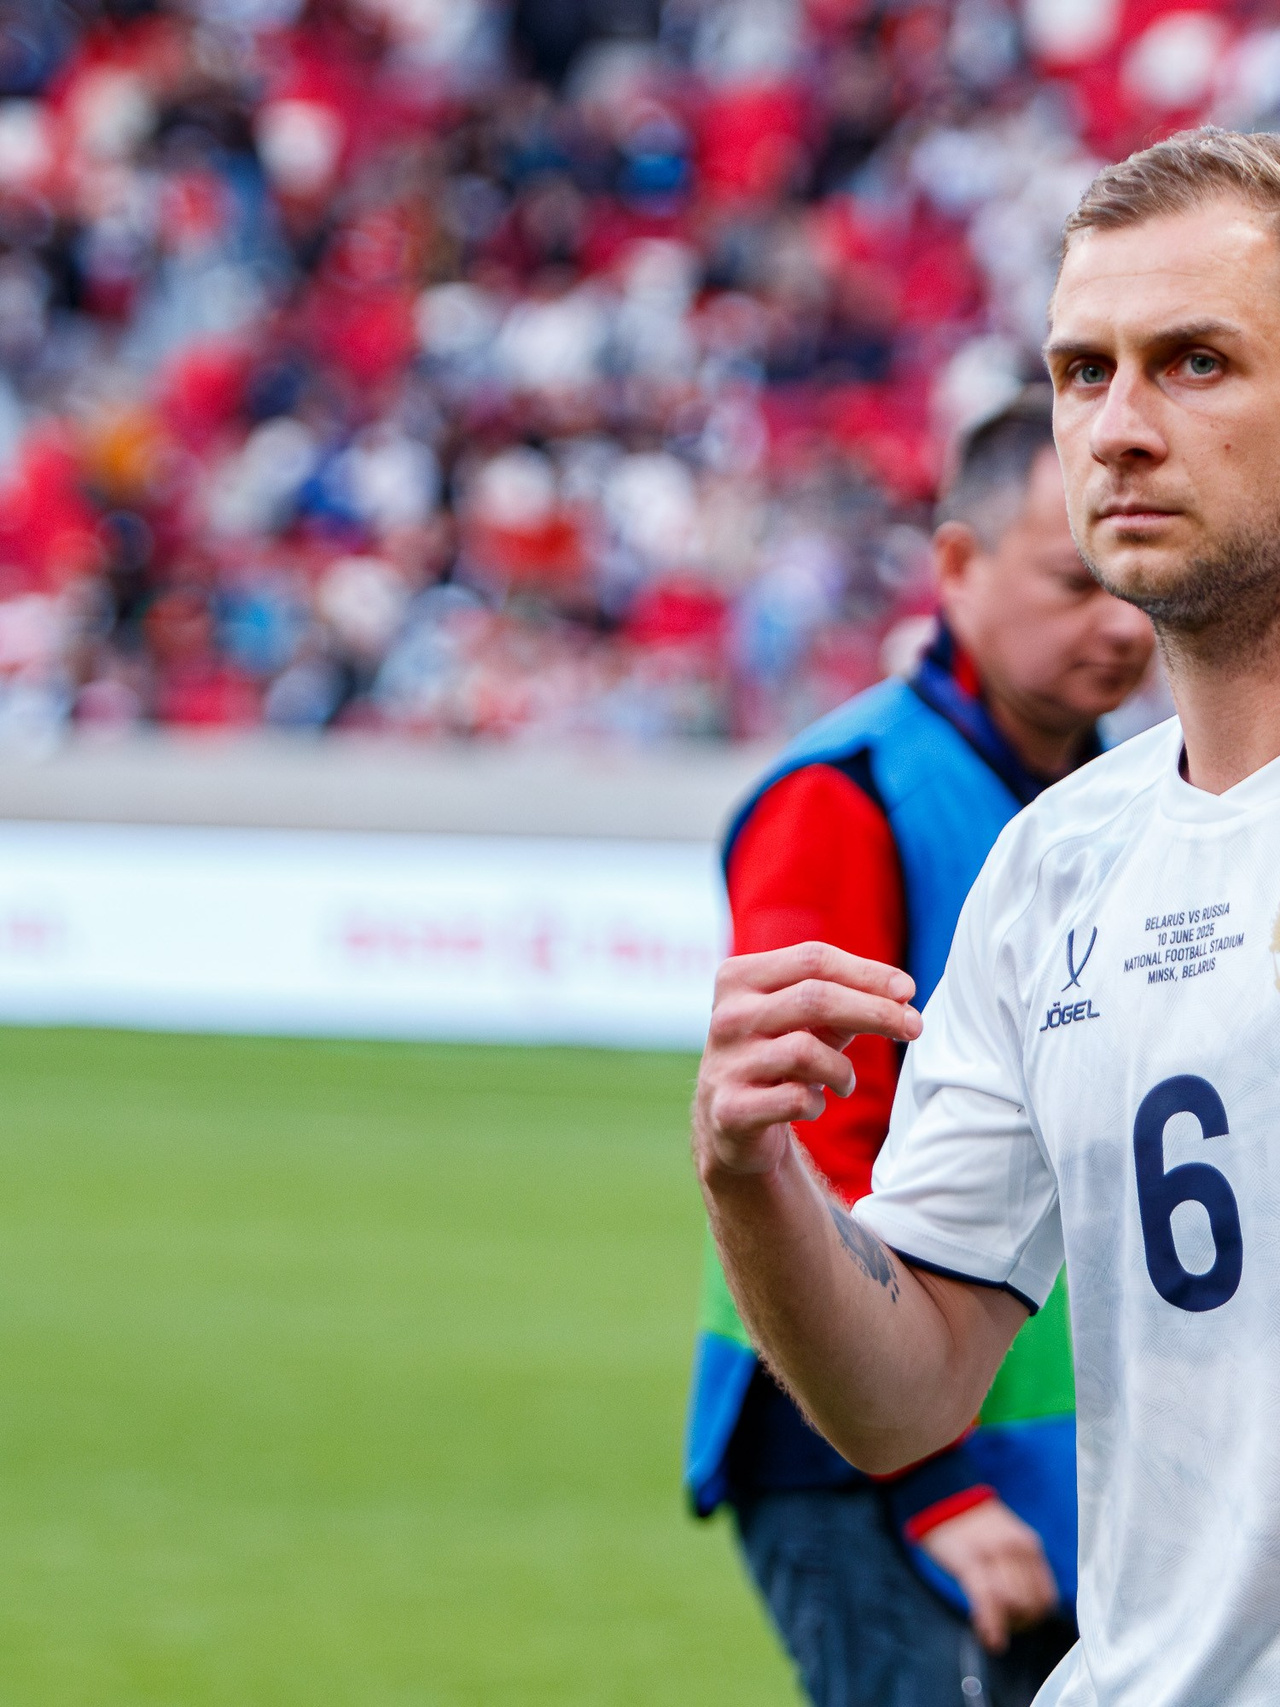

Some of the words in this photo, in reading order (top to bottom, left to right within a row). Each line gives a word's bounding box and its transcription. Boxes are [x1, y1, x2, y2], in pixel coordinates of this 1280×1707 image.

[1145, 912, 1185, 931] BELARUS
[1188, 909, 1201, 924] VS
[1202, 902, 1230, 920] RUSSIA
[1158, 932, 1168, 946] 10
[1170, 929, 1194, 944] JUNE
[1196, 923, 1215, 940] 2025
[1123, 952, 1162, 972] NATIONAL
[1165, 943, 1207, 962] FOOTBALL
[1209, 932, 1244, 953] STADIUM
[1147, 966, 1178, 984] MINSK,
[1182, 957, 1216, 979] BELARUS
[1039, 999, 1100, 1032] JÖGEL
[1133, 1074, 1243, 1312] 6
